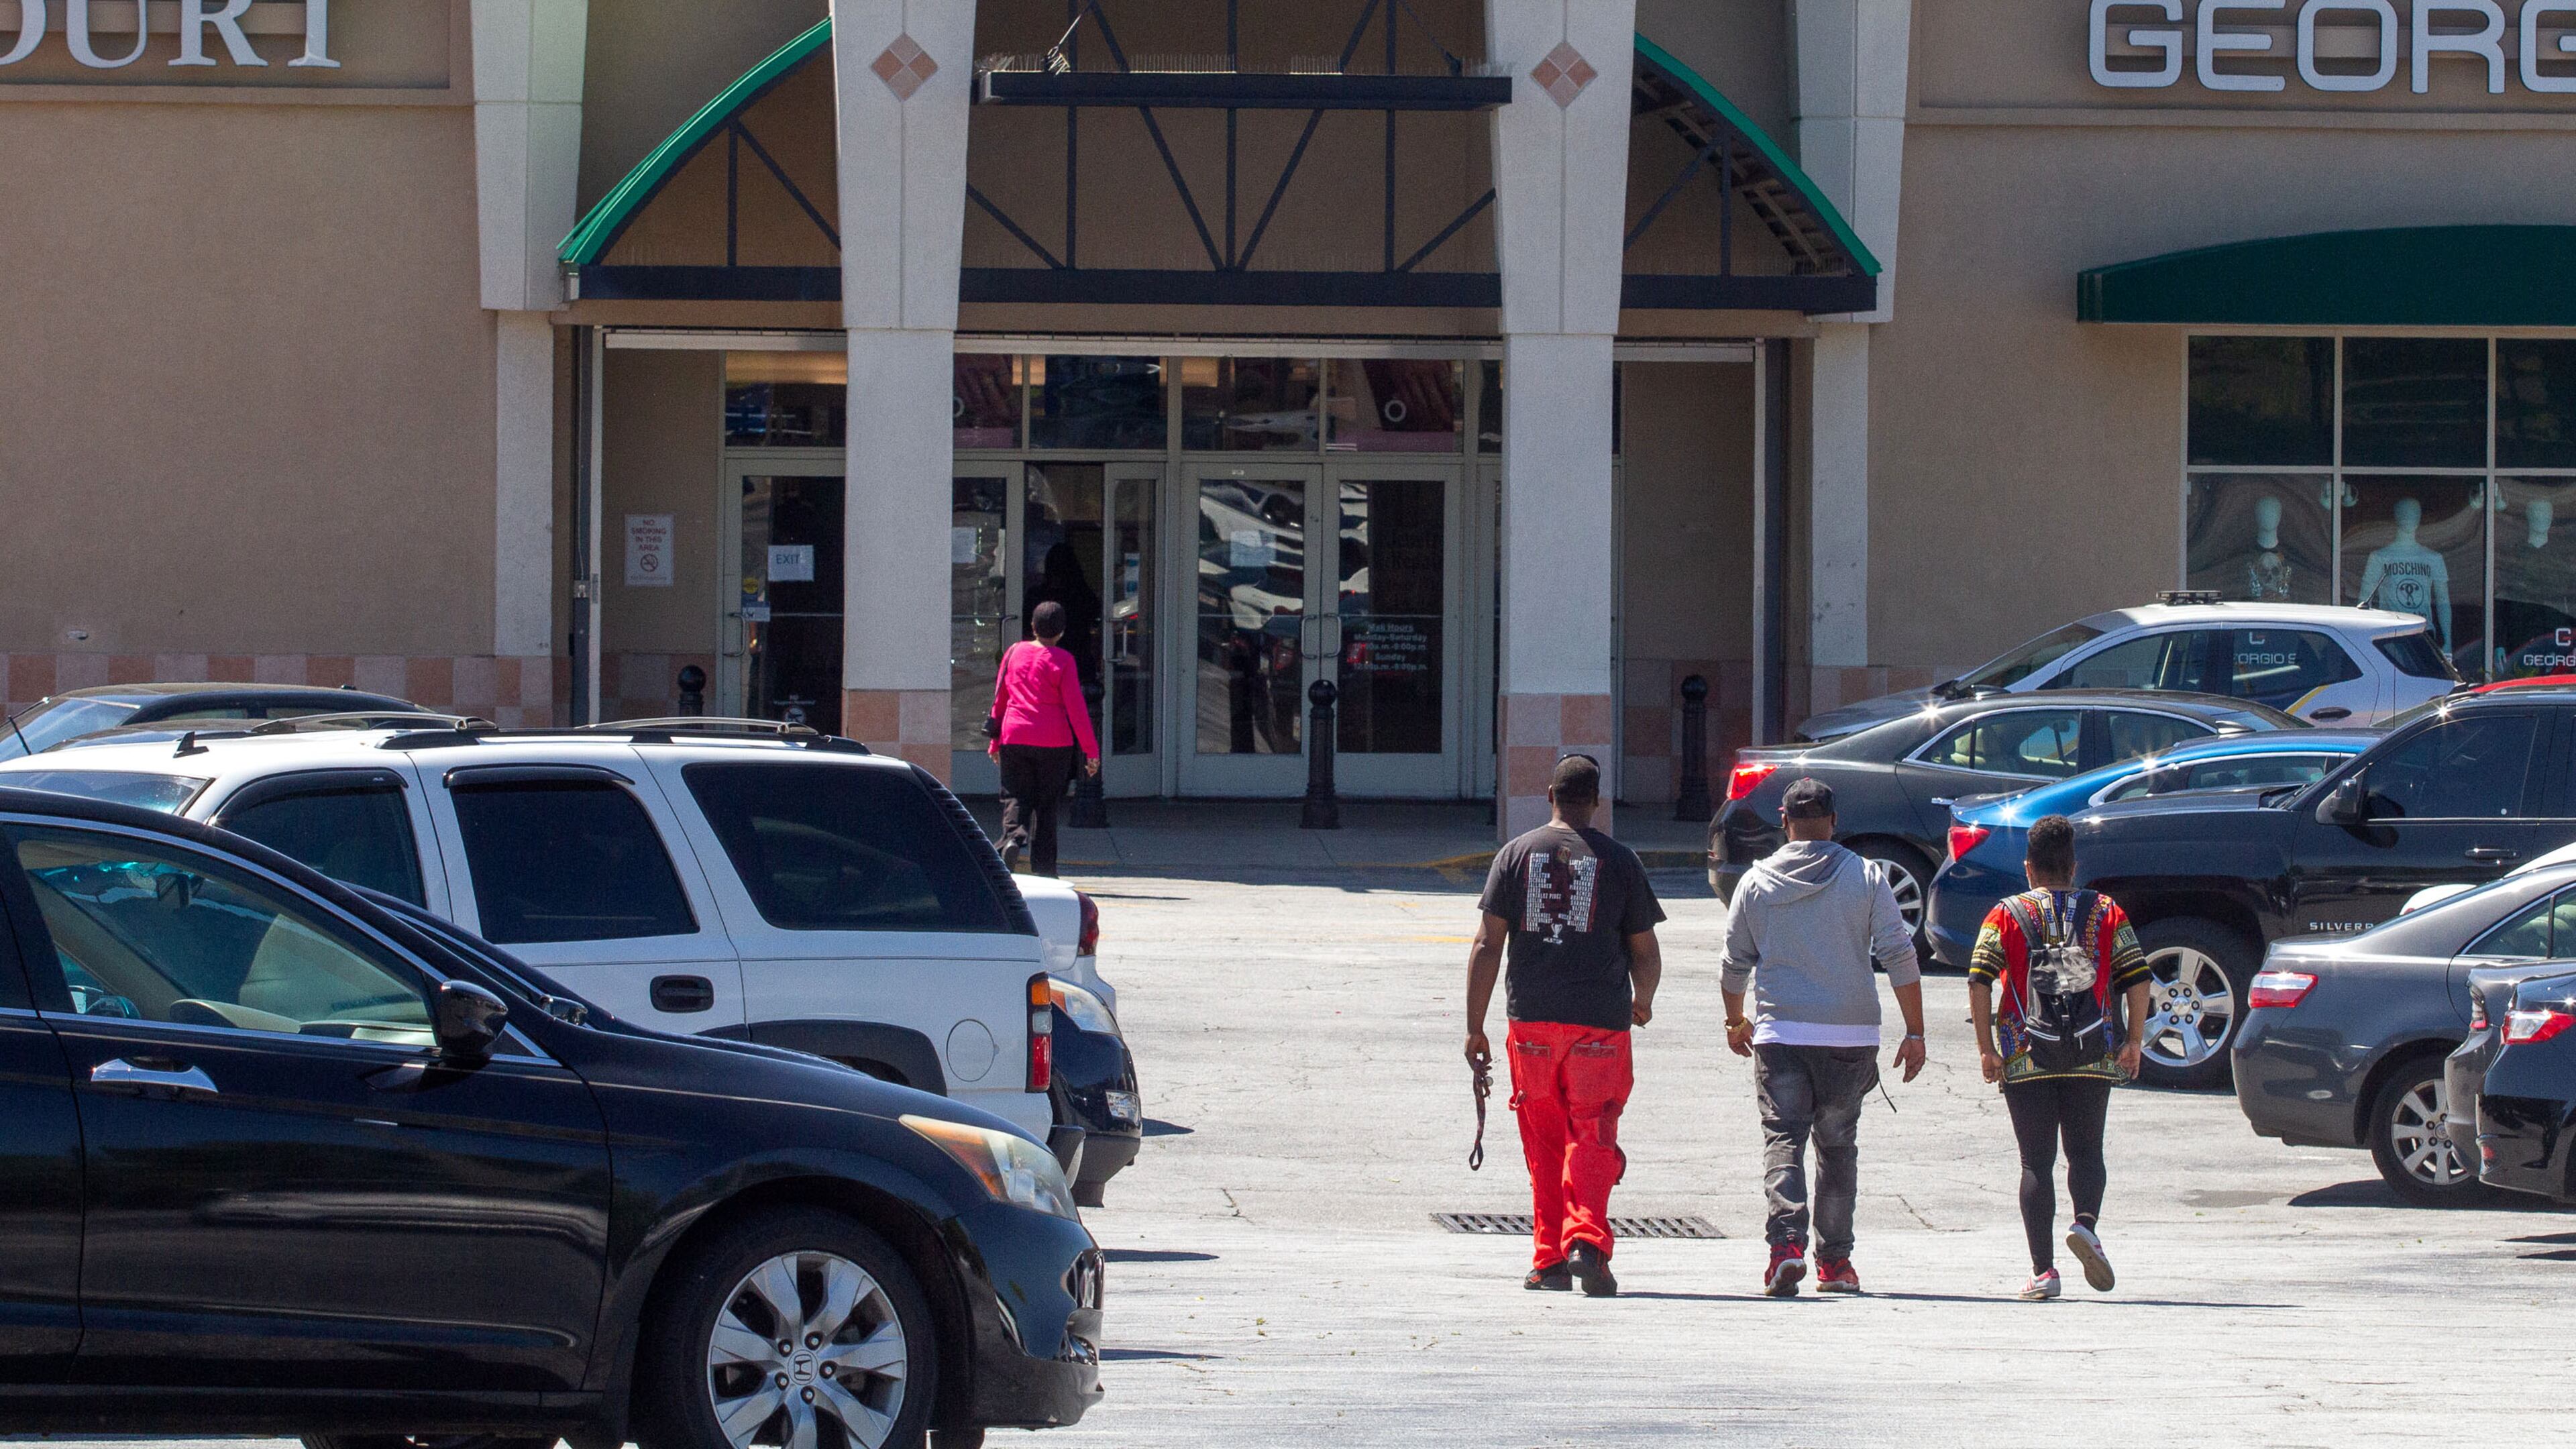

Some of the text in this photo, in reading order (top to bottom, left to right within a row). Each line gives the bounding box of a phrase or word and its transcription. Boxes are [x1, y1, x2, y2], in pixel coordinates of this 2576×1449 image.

[2089, 0, 2576, 93] GEORG
[776, 554, 800, 564] EXIT
[2383, 562, 2431, 578] MOSCHINO
[1387, 624, 1414, 633] Hours
[1354, 634, 1427, 643] Monday-Saturday
[1375, 653, 1406, 661] Sunday
[2523, 655, 2576, 667] GEORG
